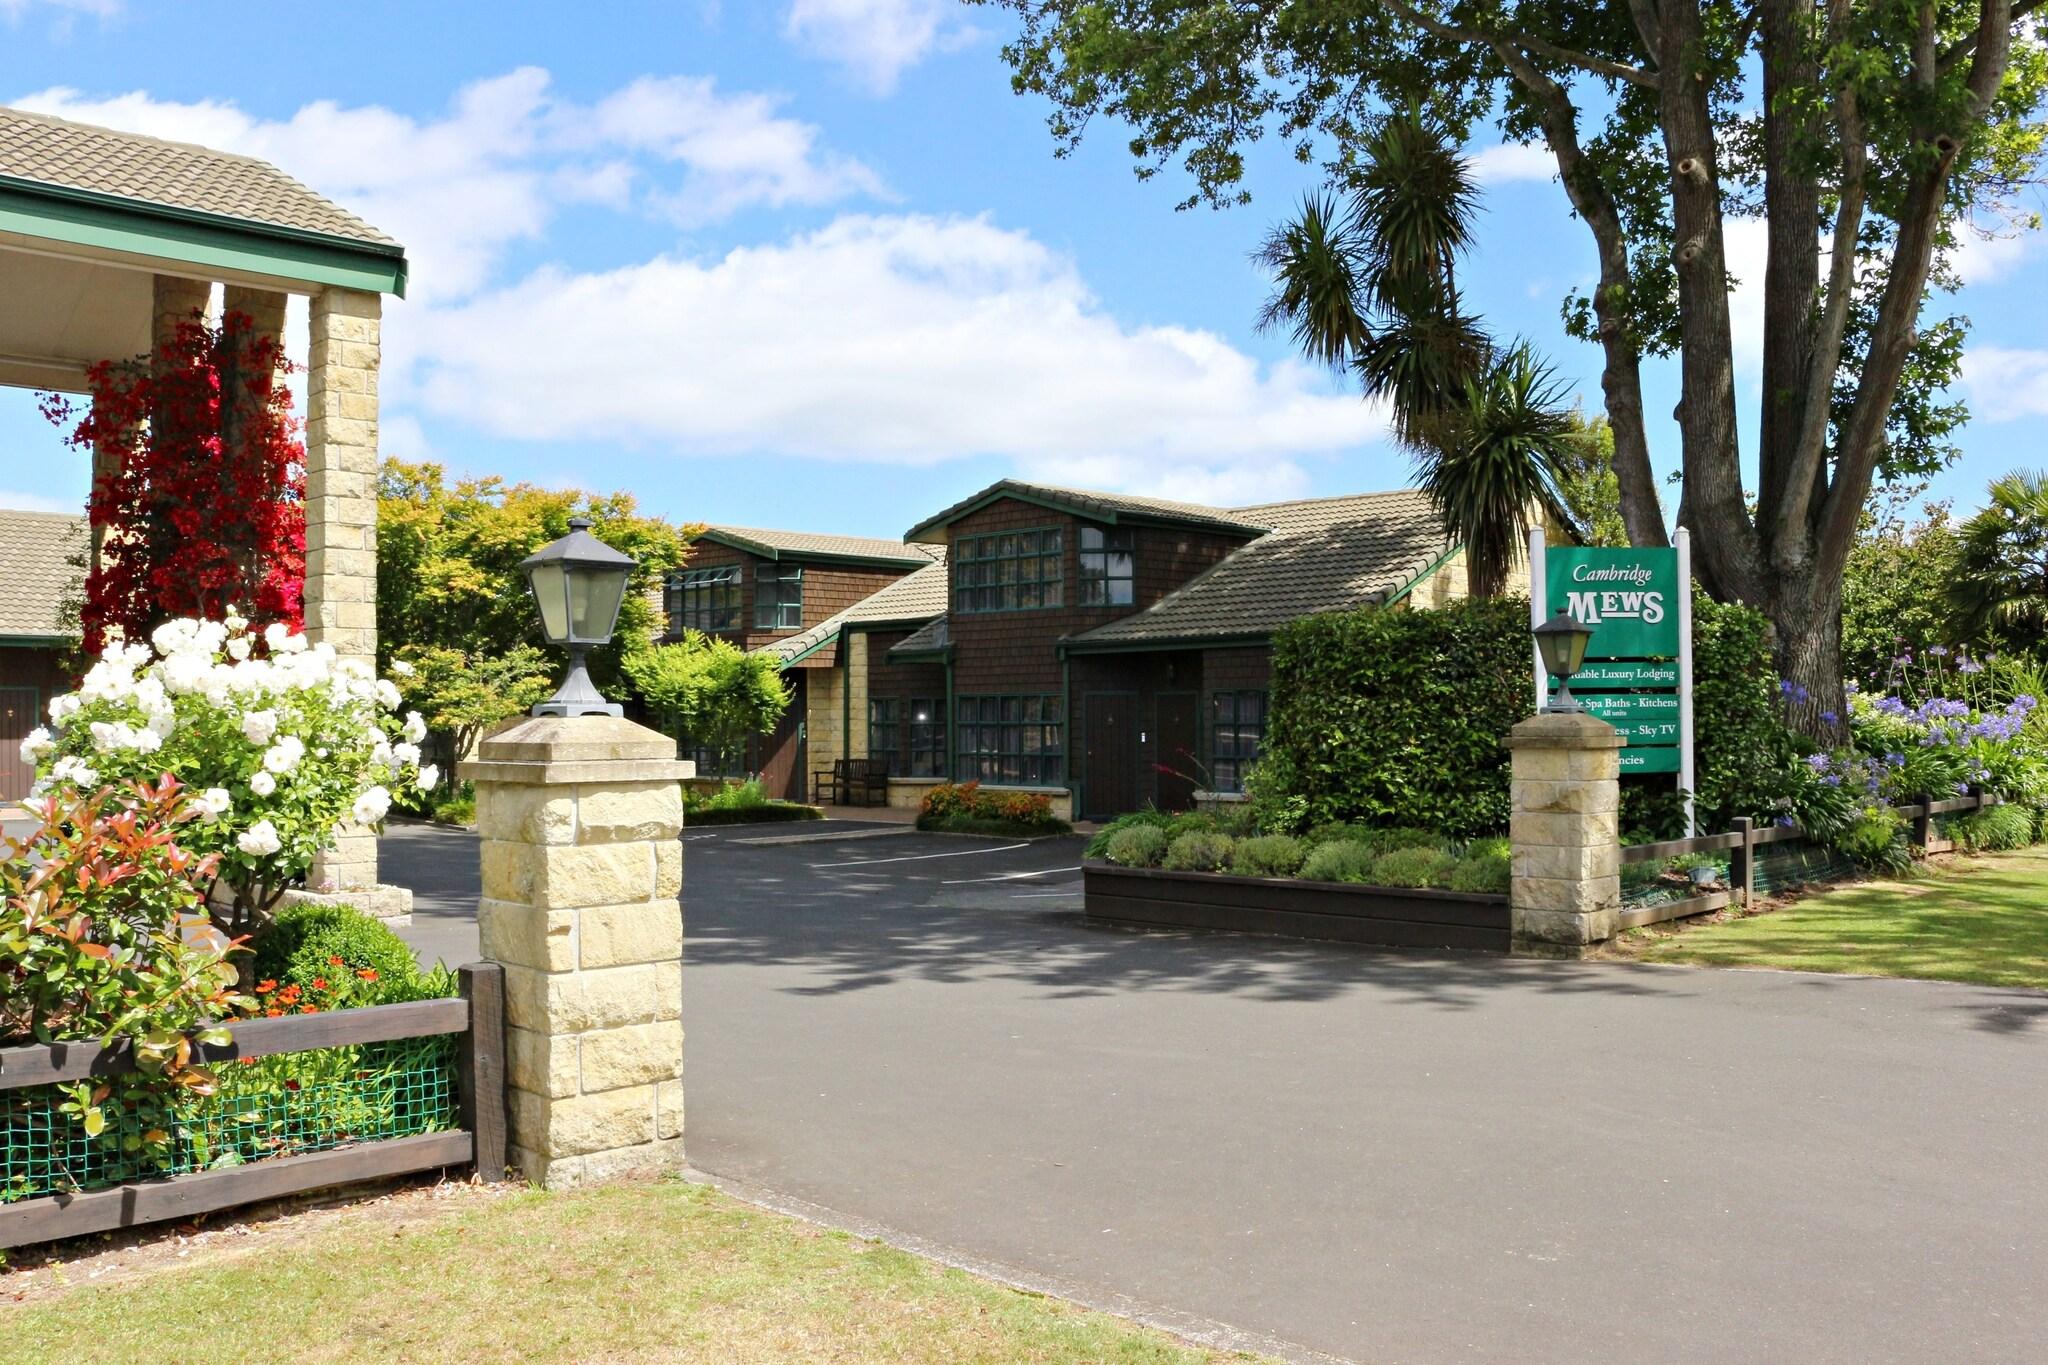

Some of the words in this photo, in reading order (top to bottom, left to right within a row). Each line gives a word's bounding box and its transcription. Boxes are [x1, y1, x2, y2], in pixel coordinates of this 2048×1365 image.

[1572, 563, 1652, 586] Cambridge
[1566, 591, 1664, 624] MEWS
[1602, 668, 1634, 680] Luxury
[1637, 668, 1675, 680] Lodging
[1585, 698, 1602, 710] Spa
[1604, 698, 1630, 708] Baths
[1639, 697, 1678, 708] Kitchens
[1639, 725, 1657, 738] Sky
[1659, 724, 1676, 734] TV
[1618, 755, 1645, 764] ncies
